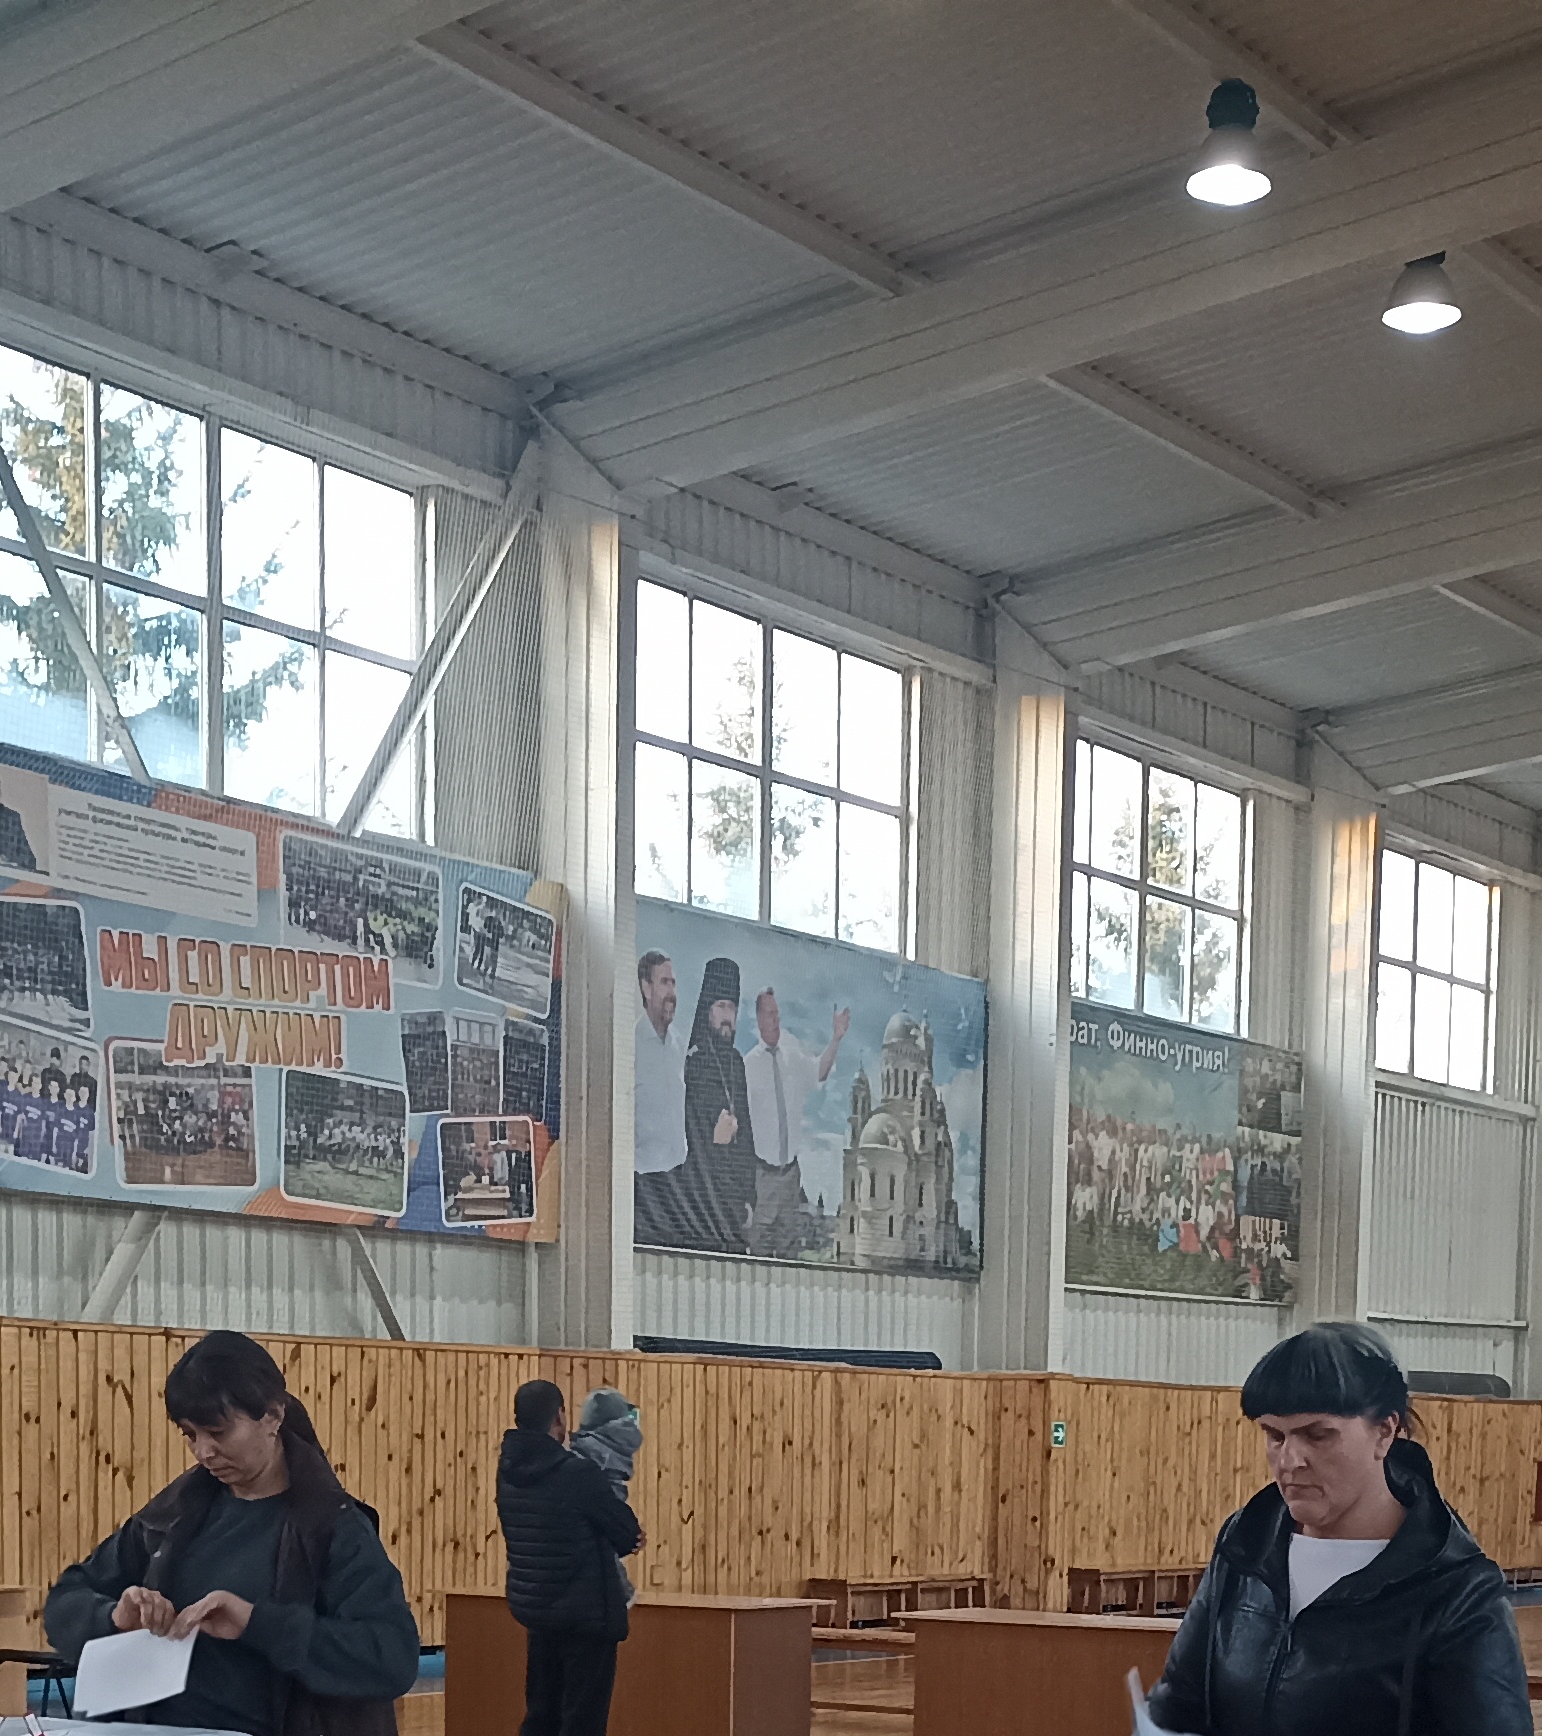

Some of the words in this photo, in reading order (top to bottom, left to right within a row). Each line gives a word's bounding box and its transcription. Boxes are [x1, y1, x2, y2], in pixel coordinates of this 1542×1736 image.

[99, 929, 169, 991] МЫ
[178, 939, 223, 998] СО
[231, 944, 391, 1011] СПОРТОМ
[164, 1004, 343, 1069] ДРУЖИМ!
[1108, 1020, 1229, 1073] Финно-угрия!
